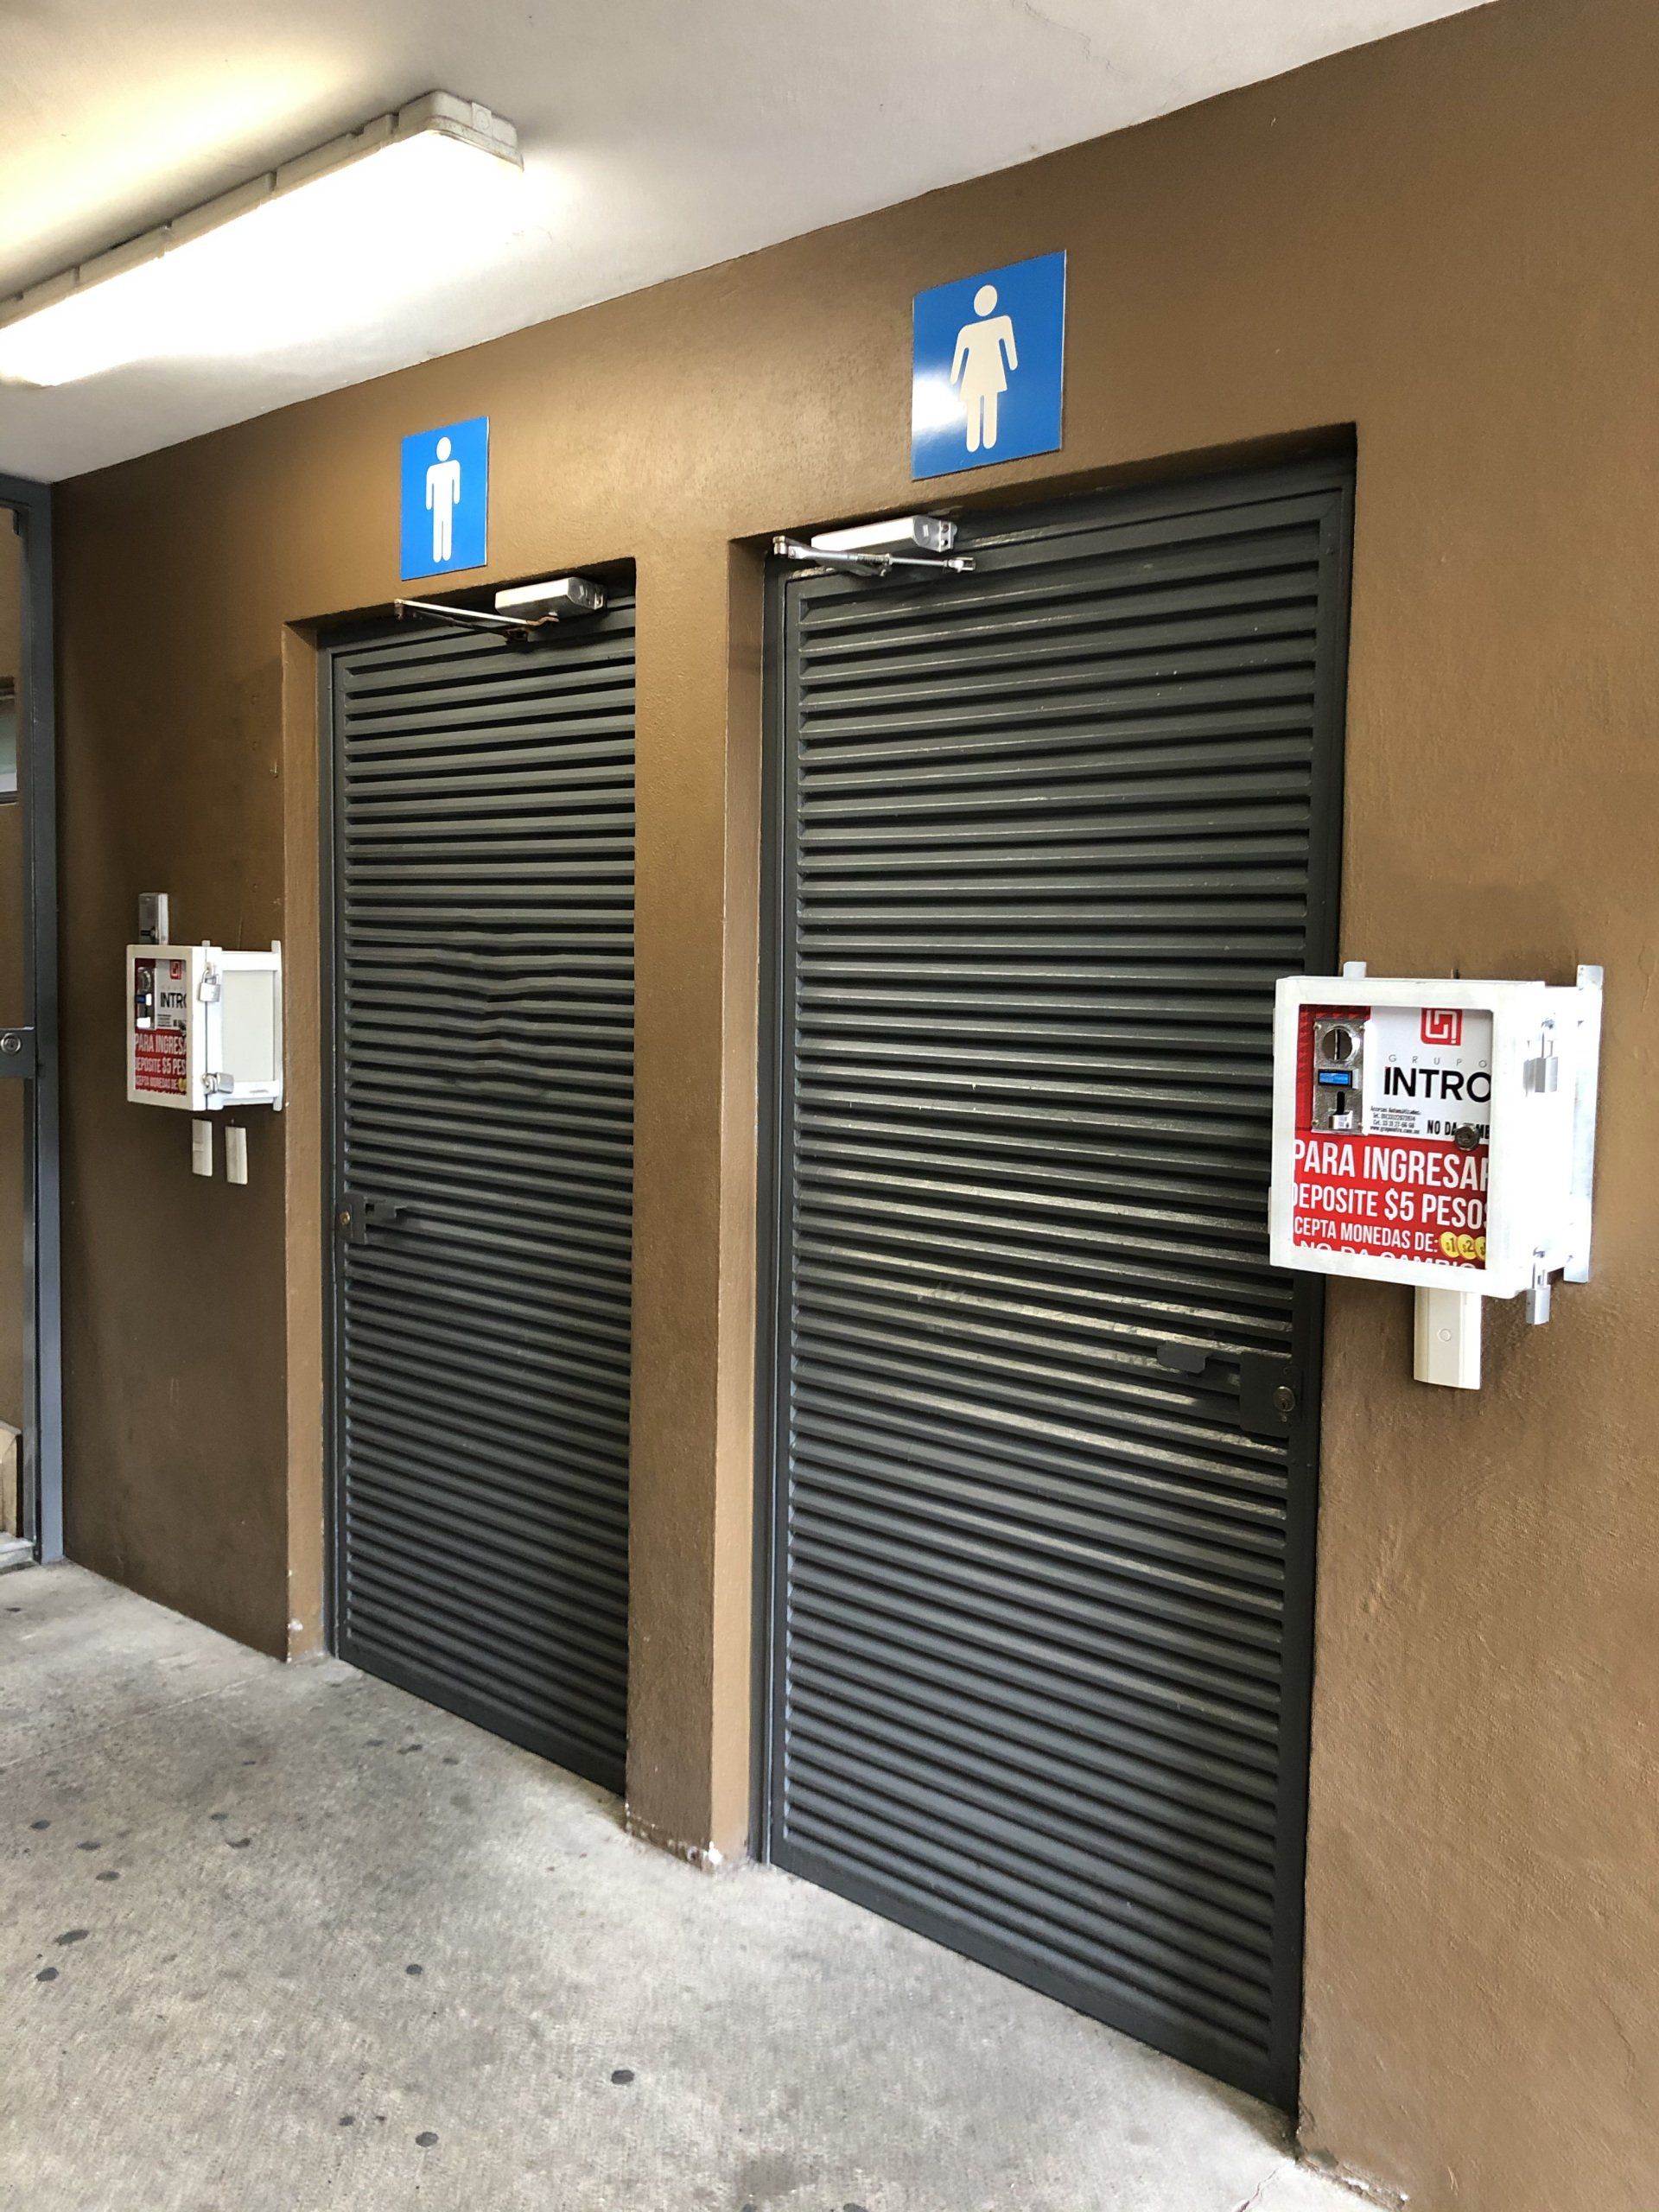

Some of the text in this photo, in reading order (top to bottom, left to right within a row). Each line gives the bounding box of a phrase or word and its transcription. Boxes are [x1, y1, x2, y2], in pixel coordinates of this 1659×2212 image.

[1388, 1053, 1488, 1069] GRUPO
[1383, 1066, 1491, 1103] INTRO
[1427, 1119, 1440, 1135] NO
[1294, 1139, 1356, 1178] PARA
[1383, 1188, 1414, 1221] $5
[1421, 1193, 1488, 1230] PESO
[1340, 1222, 1411, 1249] MONEDAS
[1414, 1230, 1439, 1253] DE:
